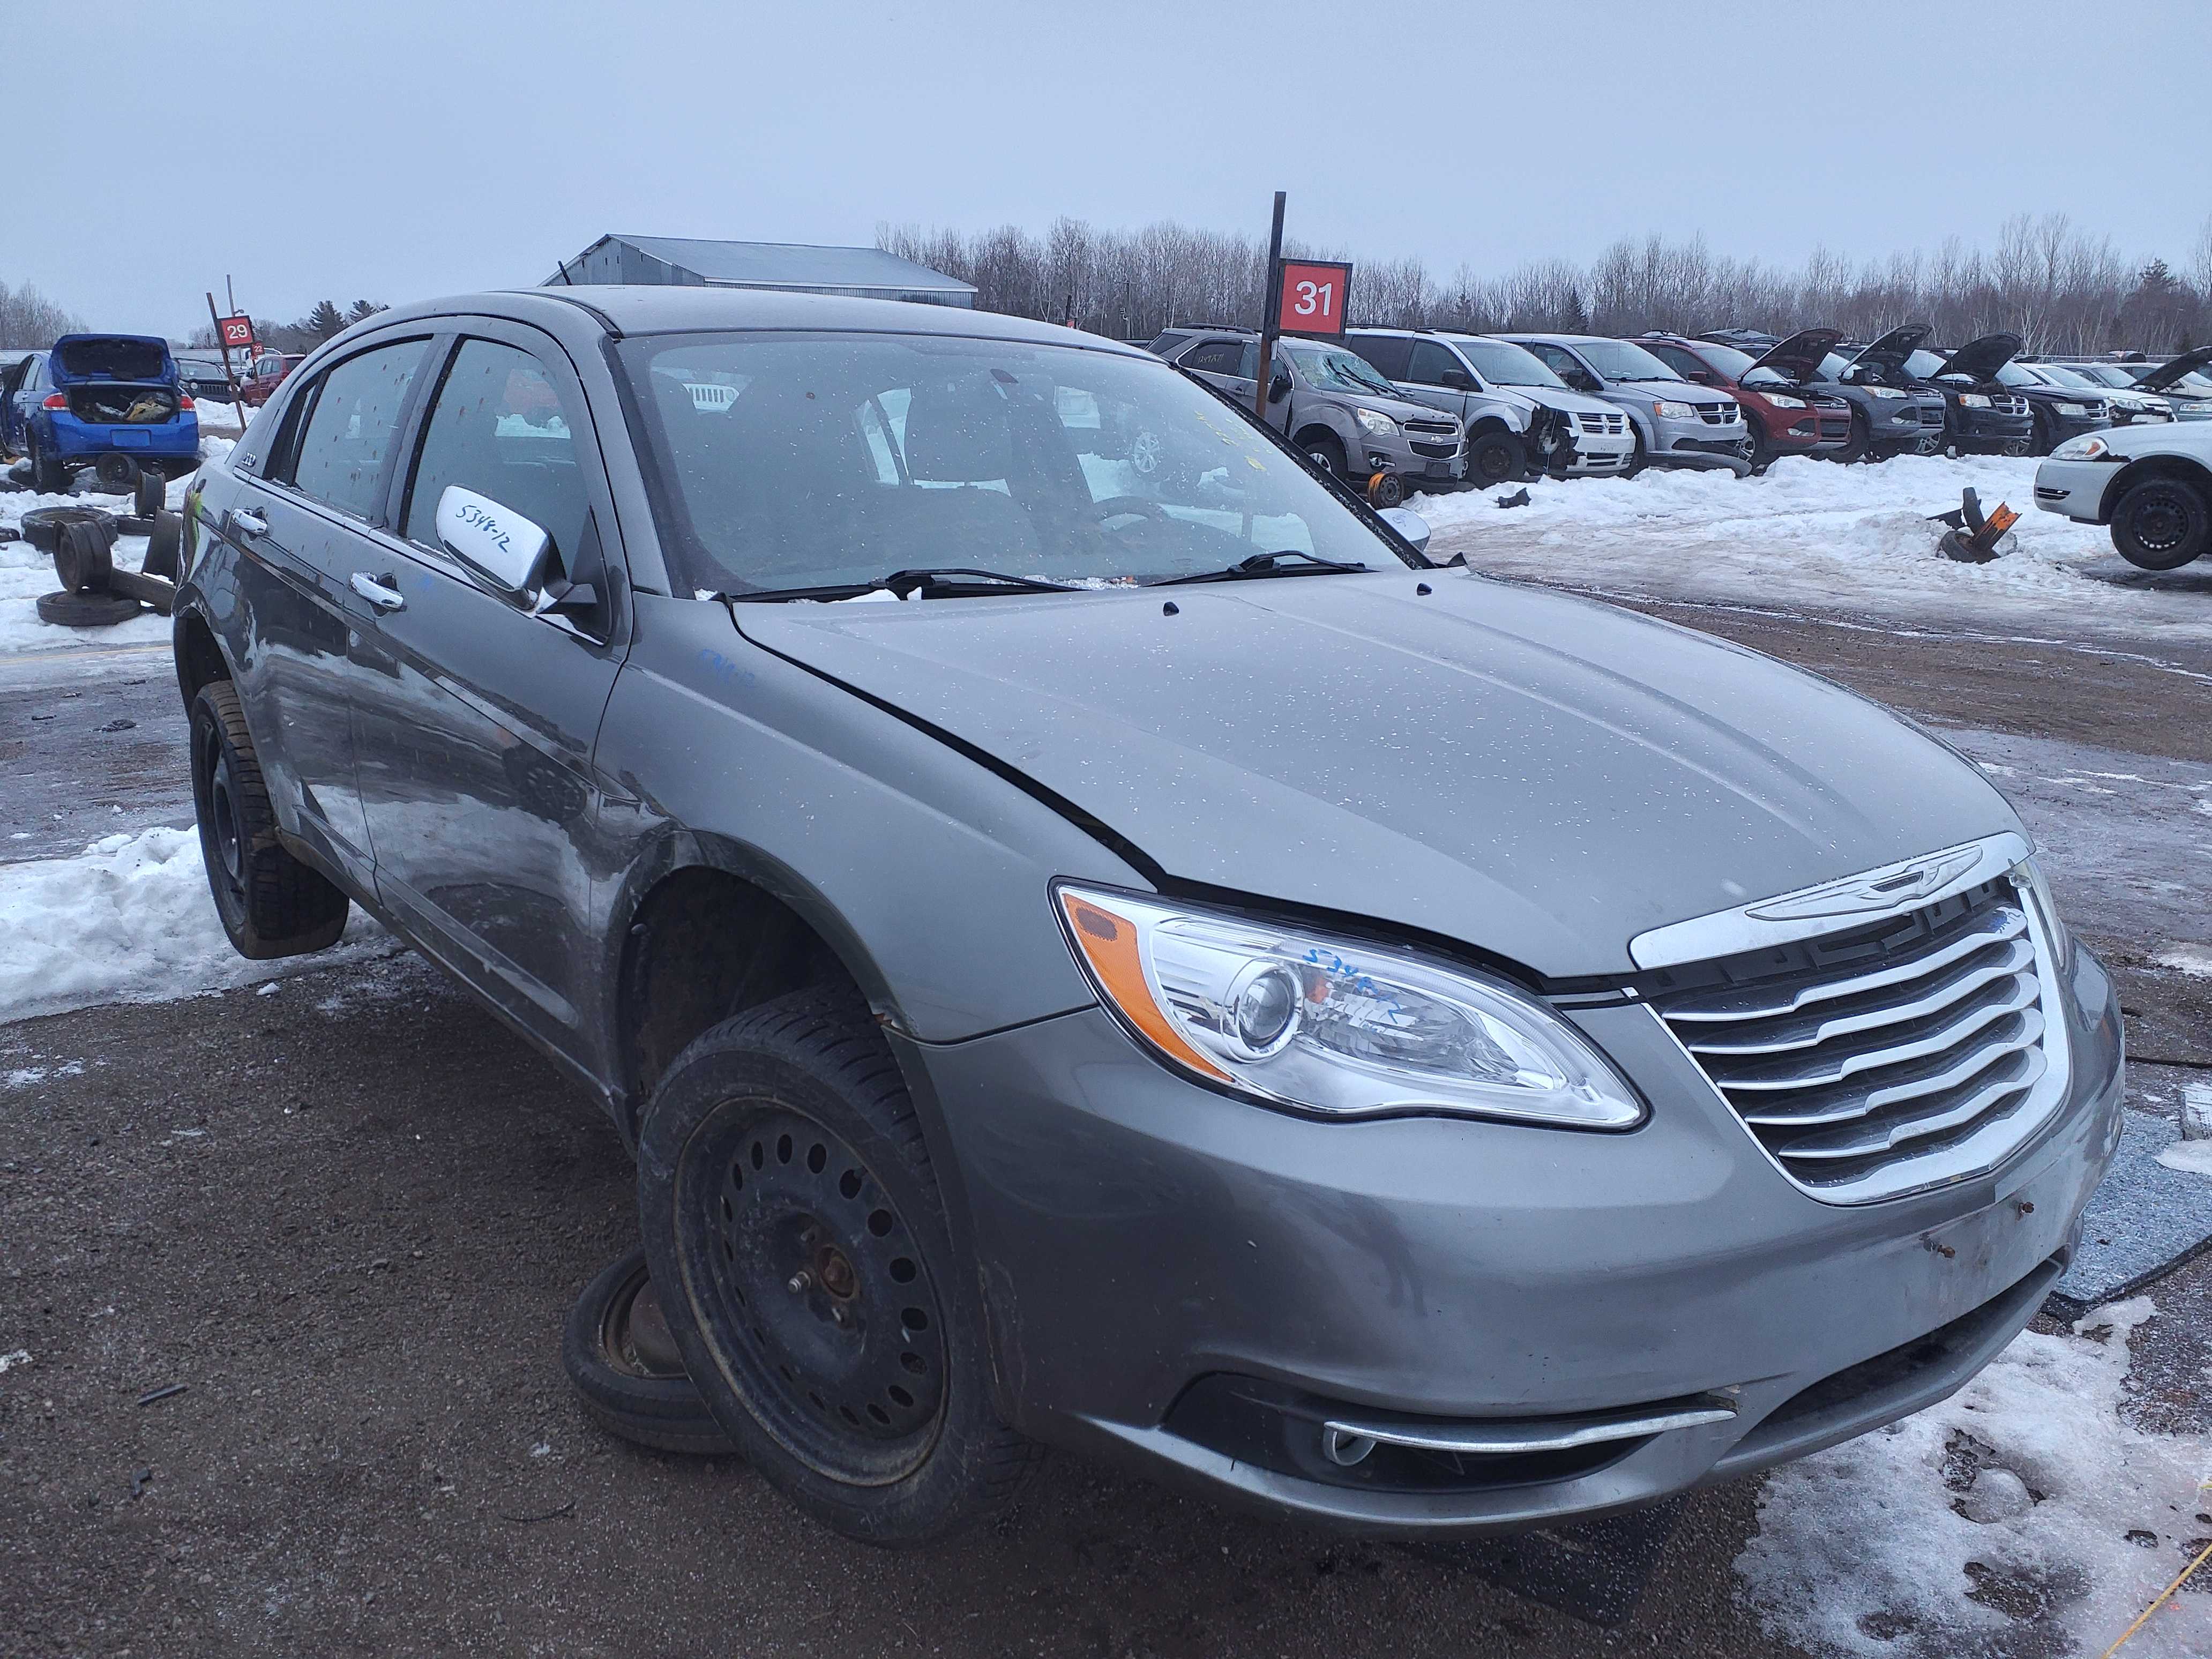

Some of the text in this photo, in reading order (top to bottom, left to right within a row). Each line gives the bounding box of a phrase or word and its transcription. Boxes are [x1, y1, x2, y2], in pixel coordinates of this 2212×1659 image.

[1295, 281, 1332, 316] 31
[227, 324, 248, 339] 29
[455, 505, 510, 553] 5348-12
